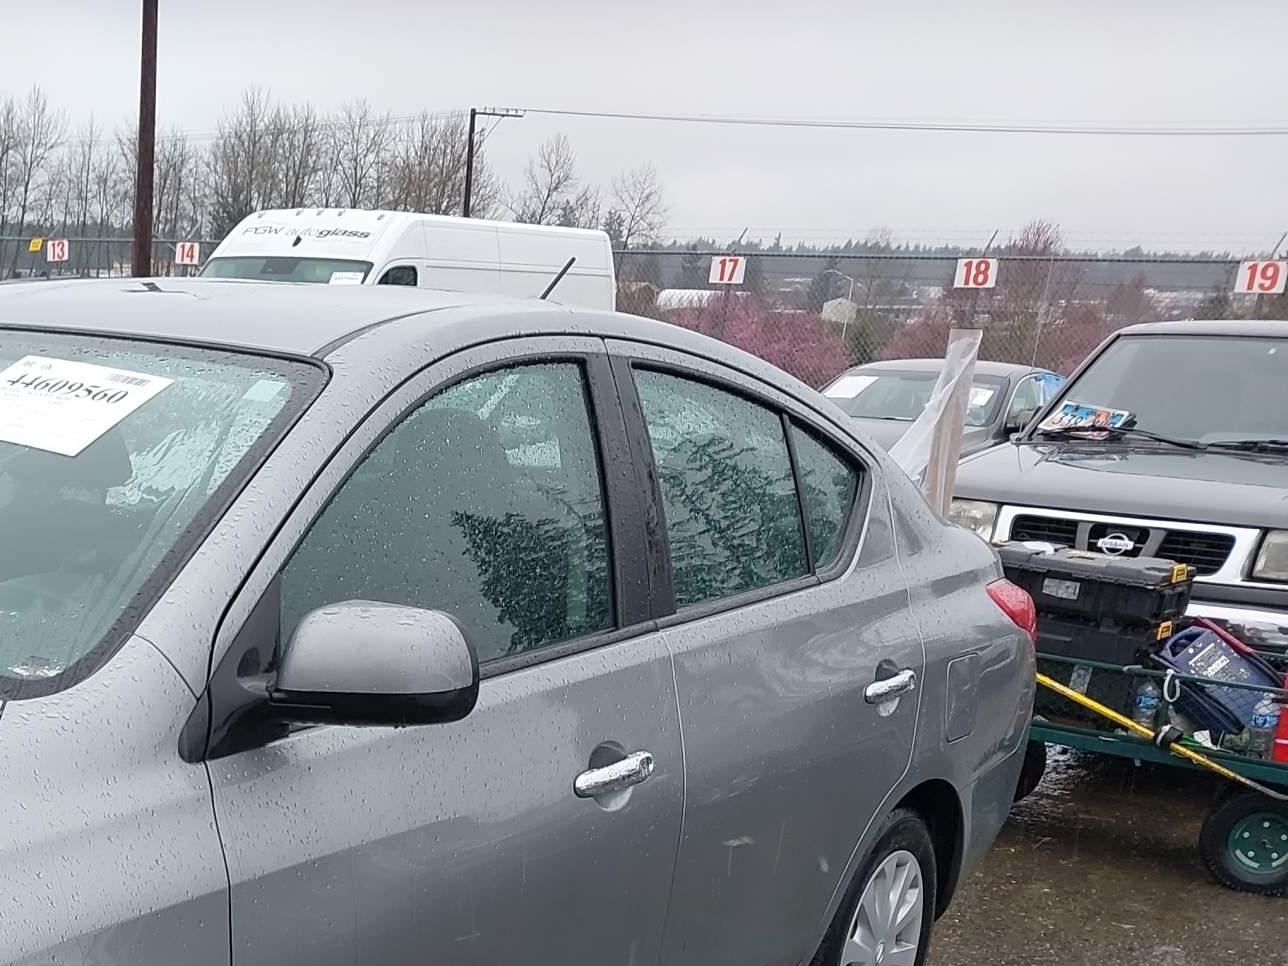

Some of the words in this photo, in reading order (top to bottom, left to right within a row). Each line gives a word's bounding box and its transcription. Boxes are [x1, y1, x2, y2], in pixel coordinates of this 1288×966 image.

[51, 241, 65, 260] 13
[179, 244, 196, 262] 14
[718, 258, 740, 282] 17
[963, 260, 991, 286] 18
[1246, 262, 1280, 291] 19
[7, 373, 129, 404] 44609560
